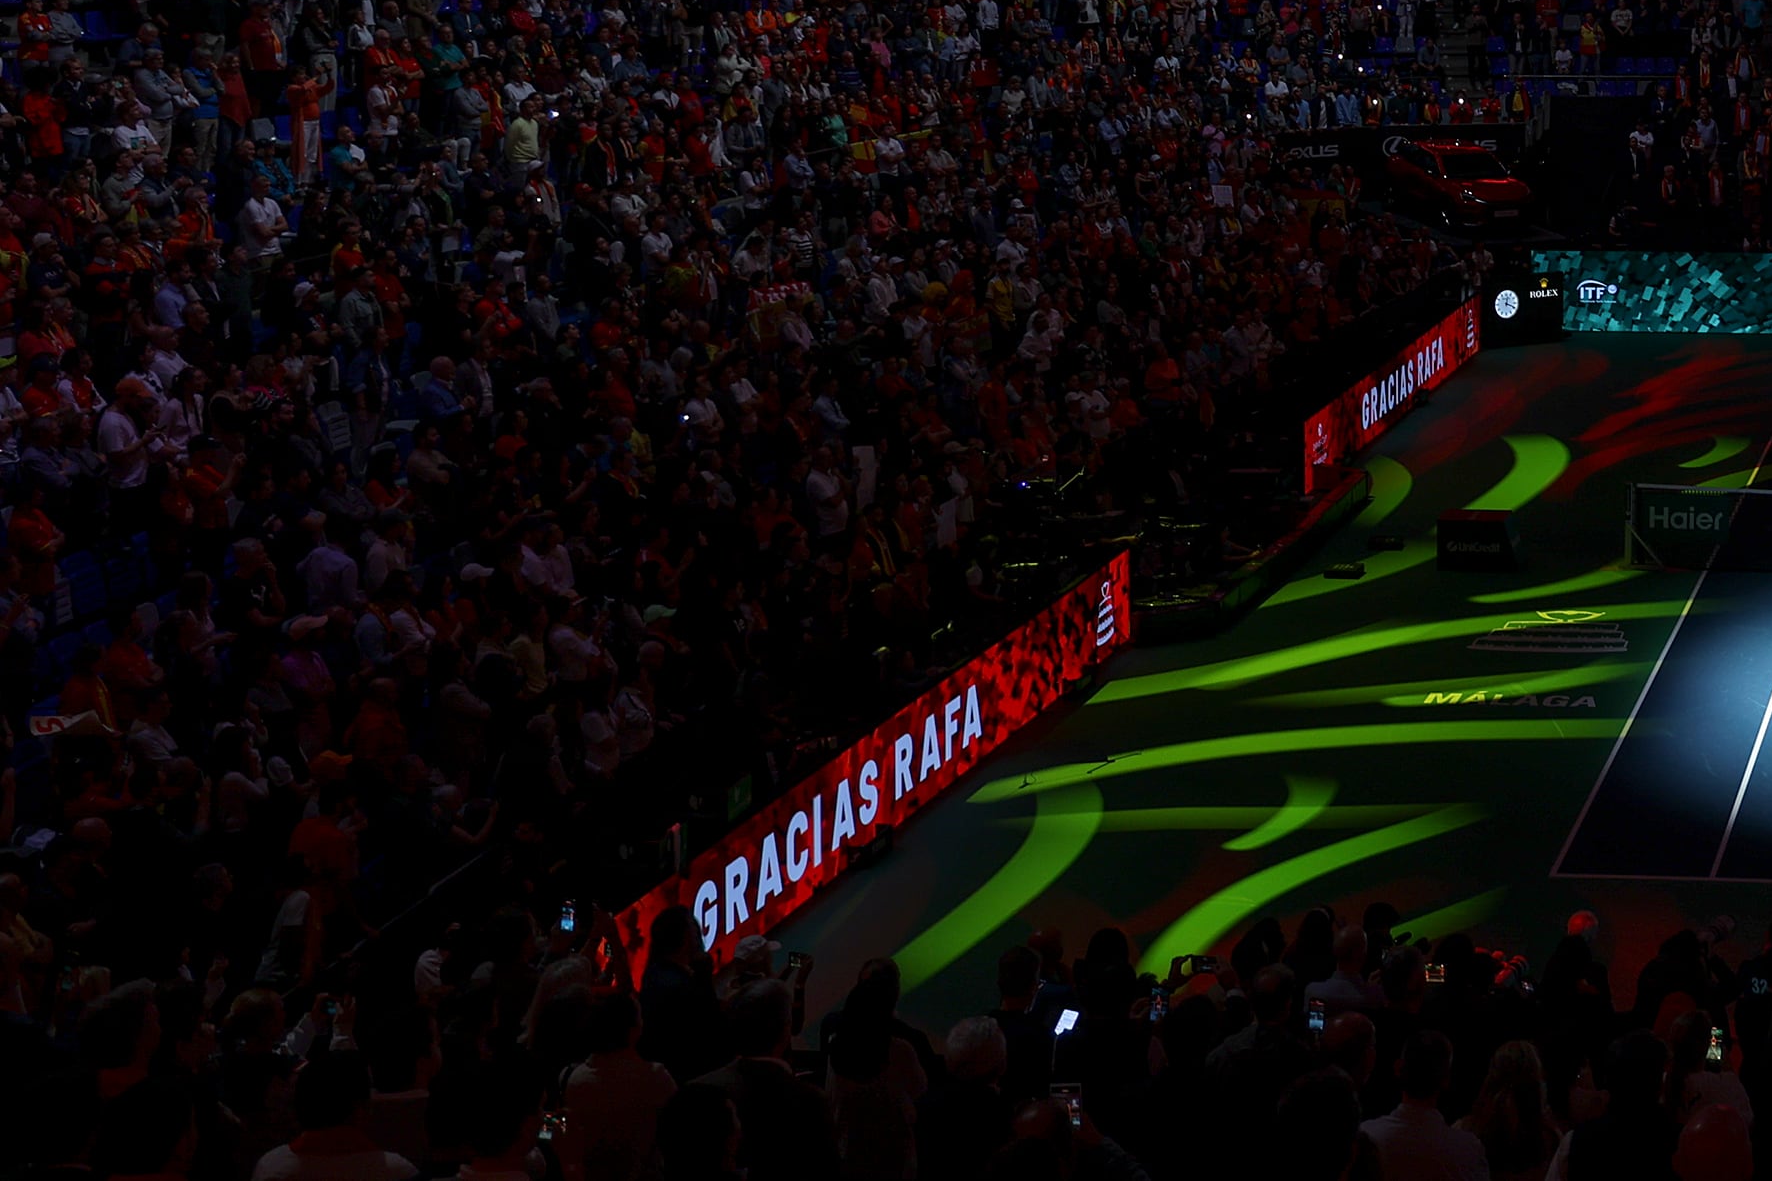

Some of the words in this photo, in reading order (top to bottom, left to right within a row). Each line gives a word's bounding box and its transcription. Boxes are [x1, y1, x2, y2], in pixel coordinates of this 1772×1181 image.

[1529, 288, 1559, 299] ROLEX
[1579, 286, 1605, 300] ITF
[1361, 359, 1414, 430] GRACIAS
[1417, 335, 1444, 387] RAFA
[1649, 505, 1724, 531] Haier
[1423, 690, 1597, 708] MÁLAGA
[693, 759, 878, 953] GRACIAS
[894, 683, 982, 802] RAFA
